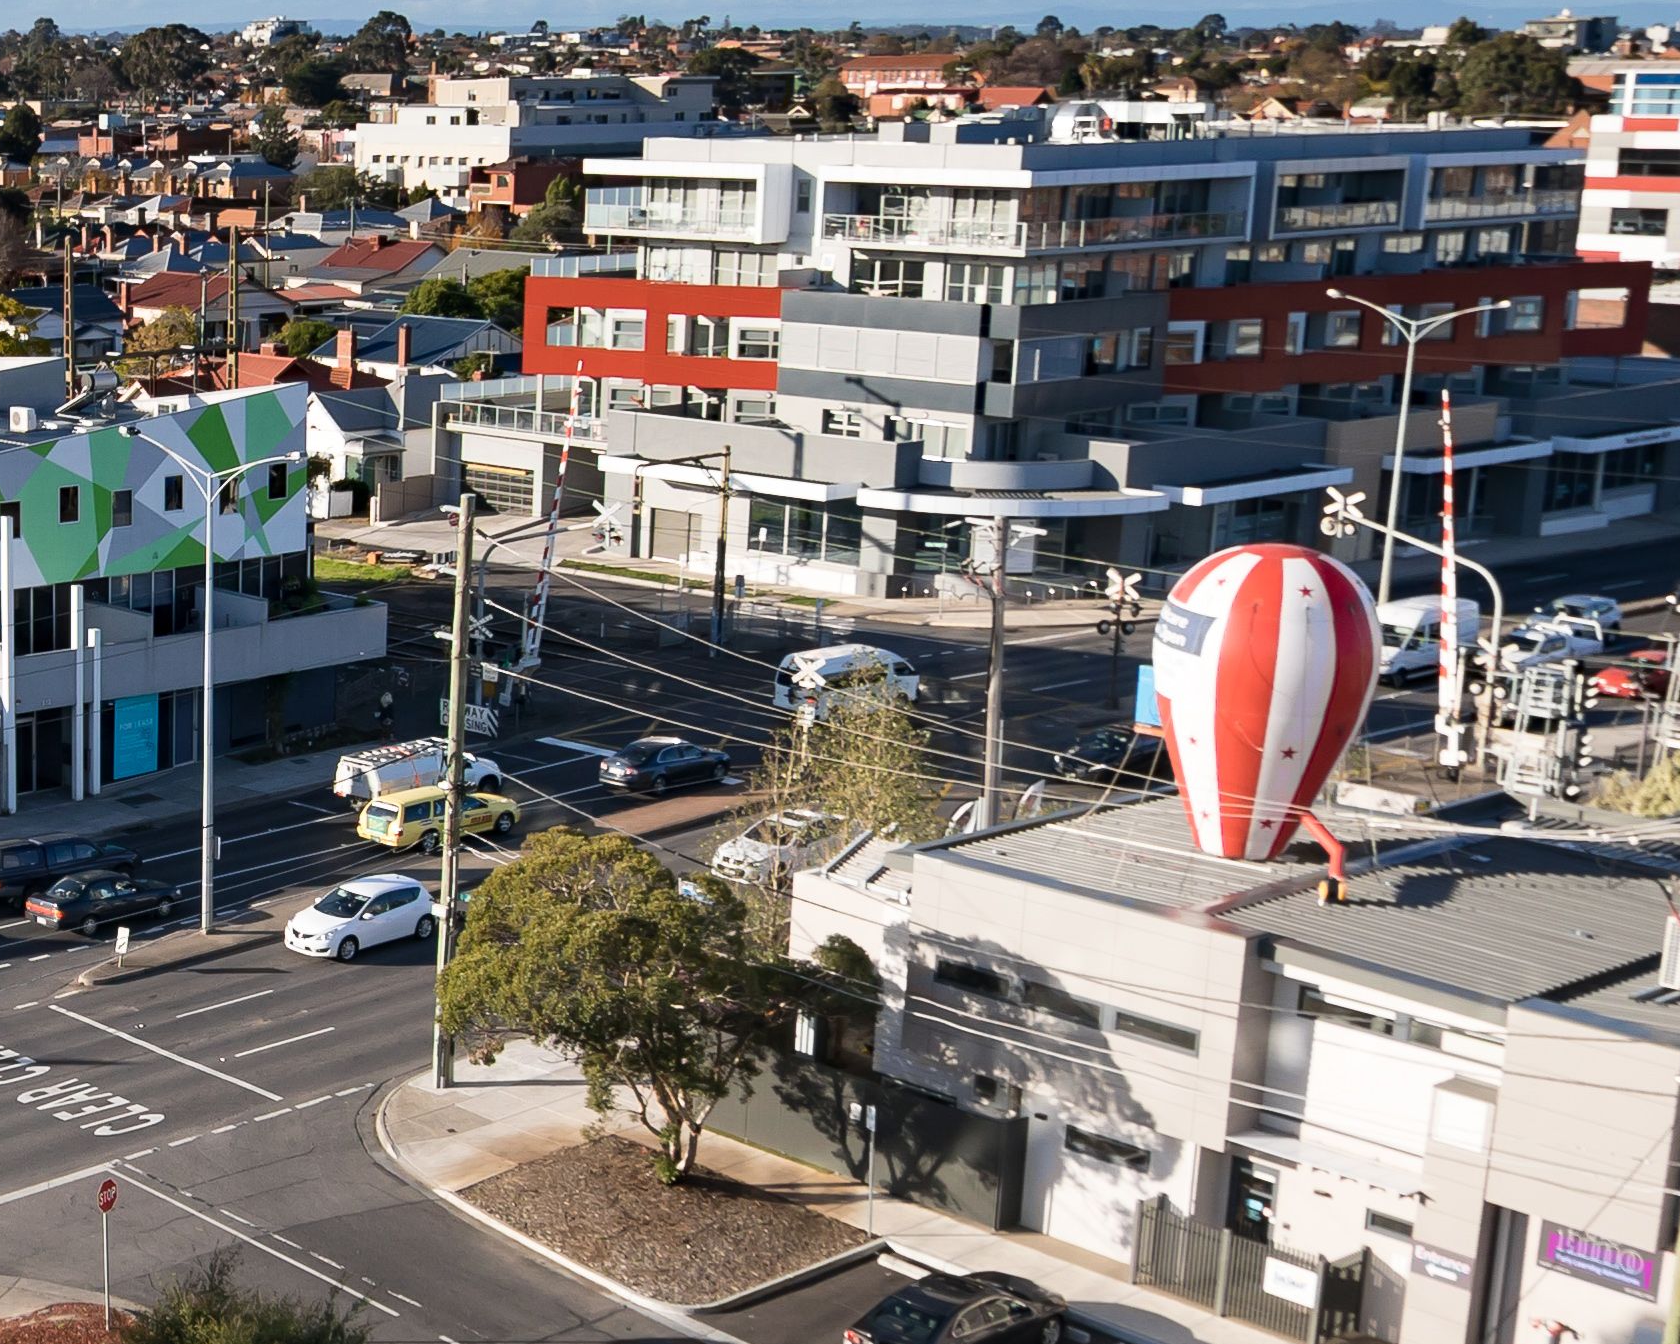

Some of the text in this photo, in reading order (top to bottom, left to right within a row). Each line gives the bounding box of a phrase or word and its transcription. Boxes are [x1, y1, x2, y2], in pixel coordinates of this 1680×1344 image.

[442, 700, 485, 719] RWAY
[442, 715, 489, 734] CSING
[16, 1078, 166, 1137] CLEAR
[100, 1186, 116, 1206] STOP
